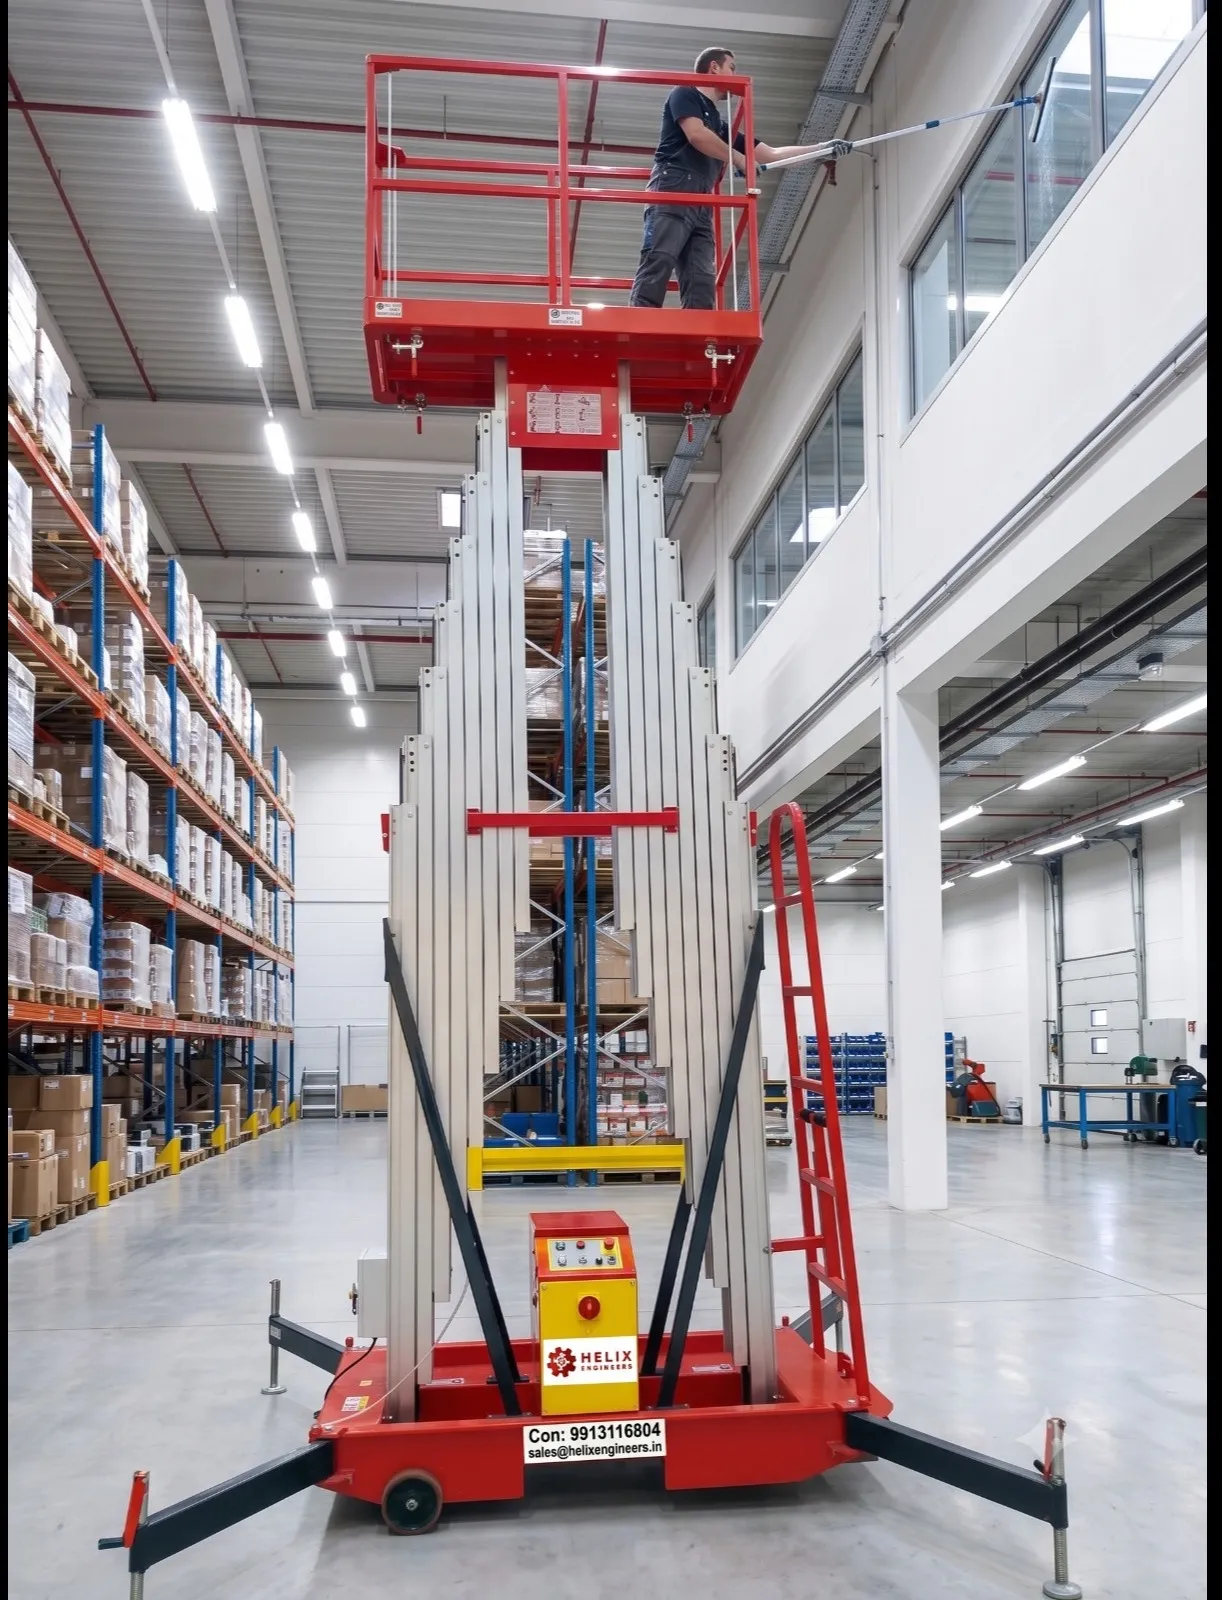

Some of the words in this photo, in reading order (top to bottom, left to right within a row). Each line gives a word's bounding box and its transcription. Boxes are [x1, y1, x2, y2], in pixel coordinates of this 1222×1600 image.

[581, 1350, 632, 1363] HELIX
[580, 1363, 633, 1371] ENGINEERS
[528, 1428, 566, 1443] Con:
[570, 1422, 661, 1441] 9913116804
[528, 1441, 662, 1459] sales@helixengineers.in
